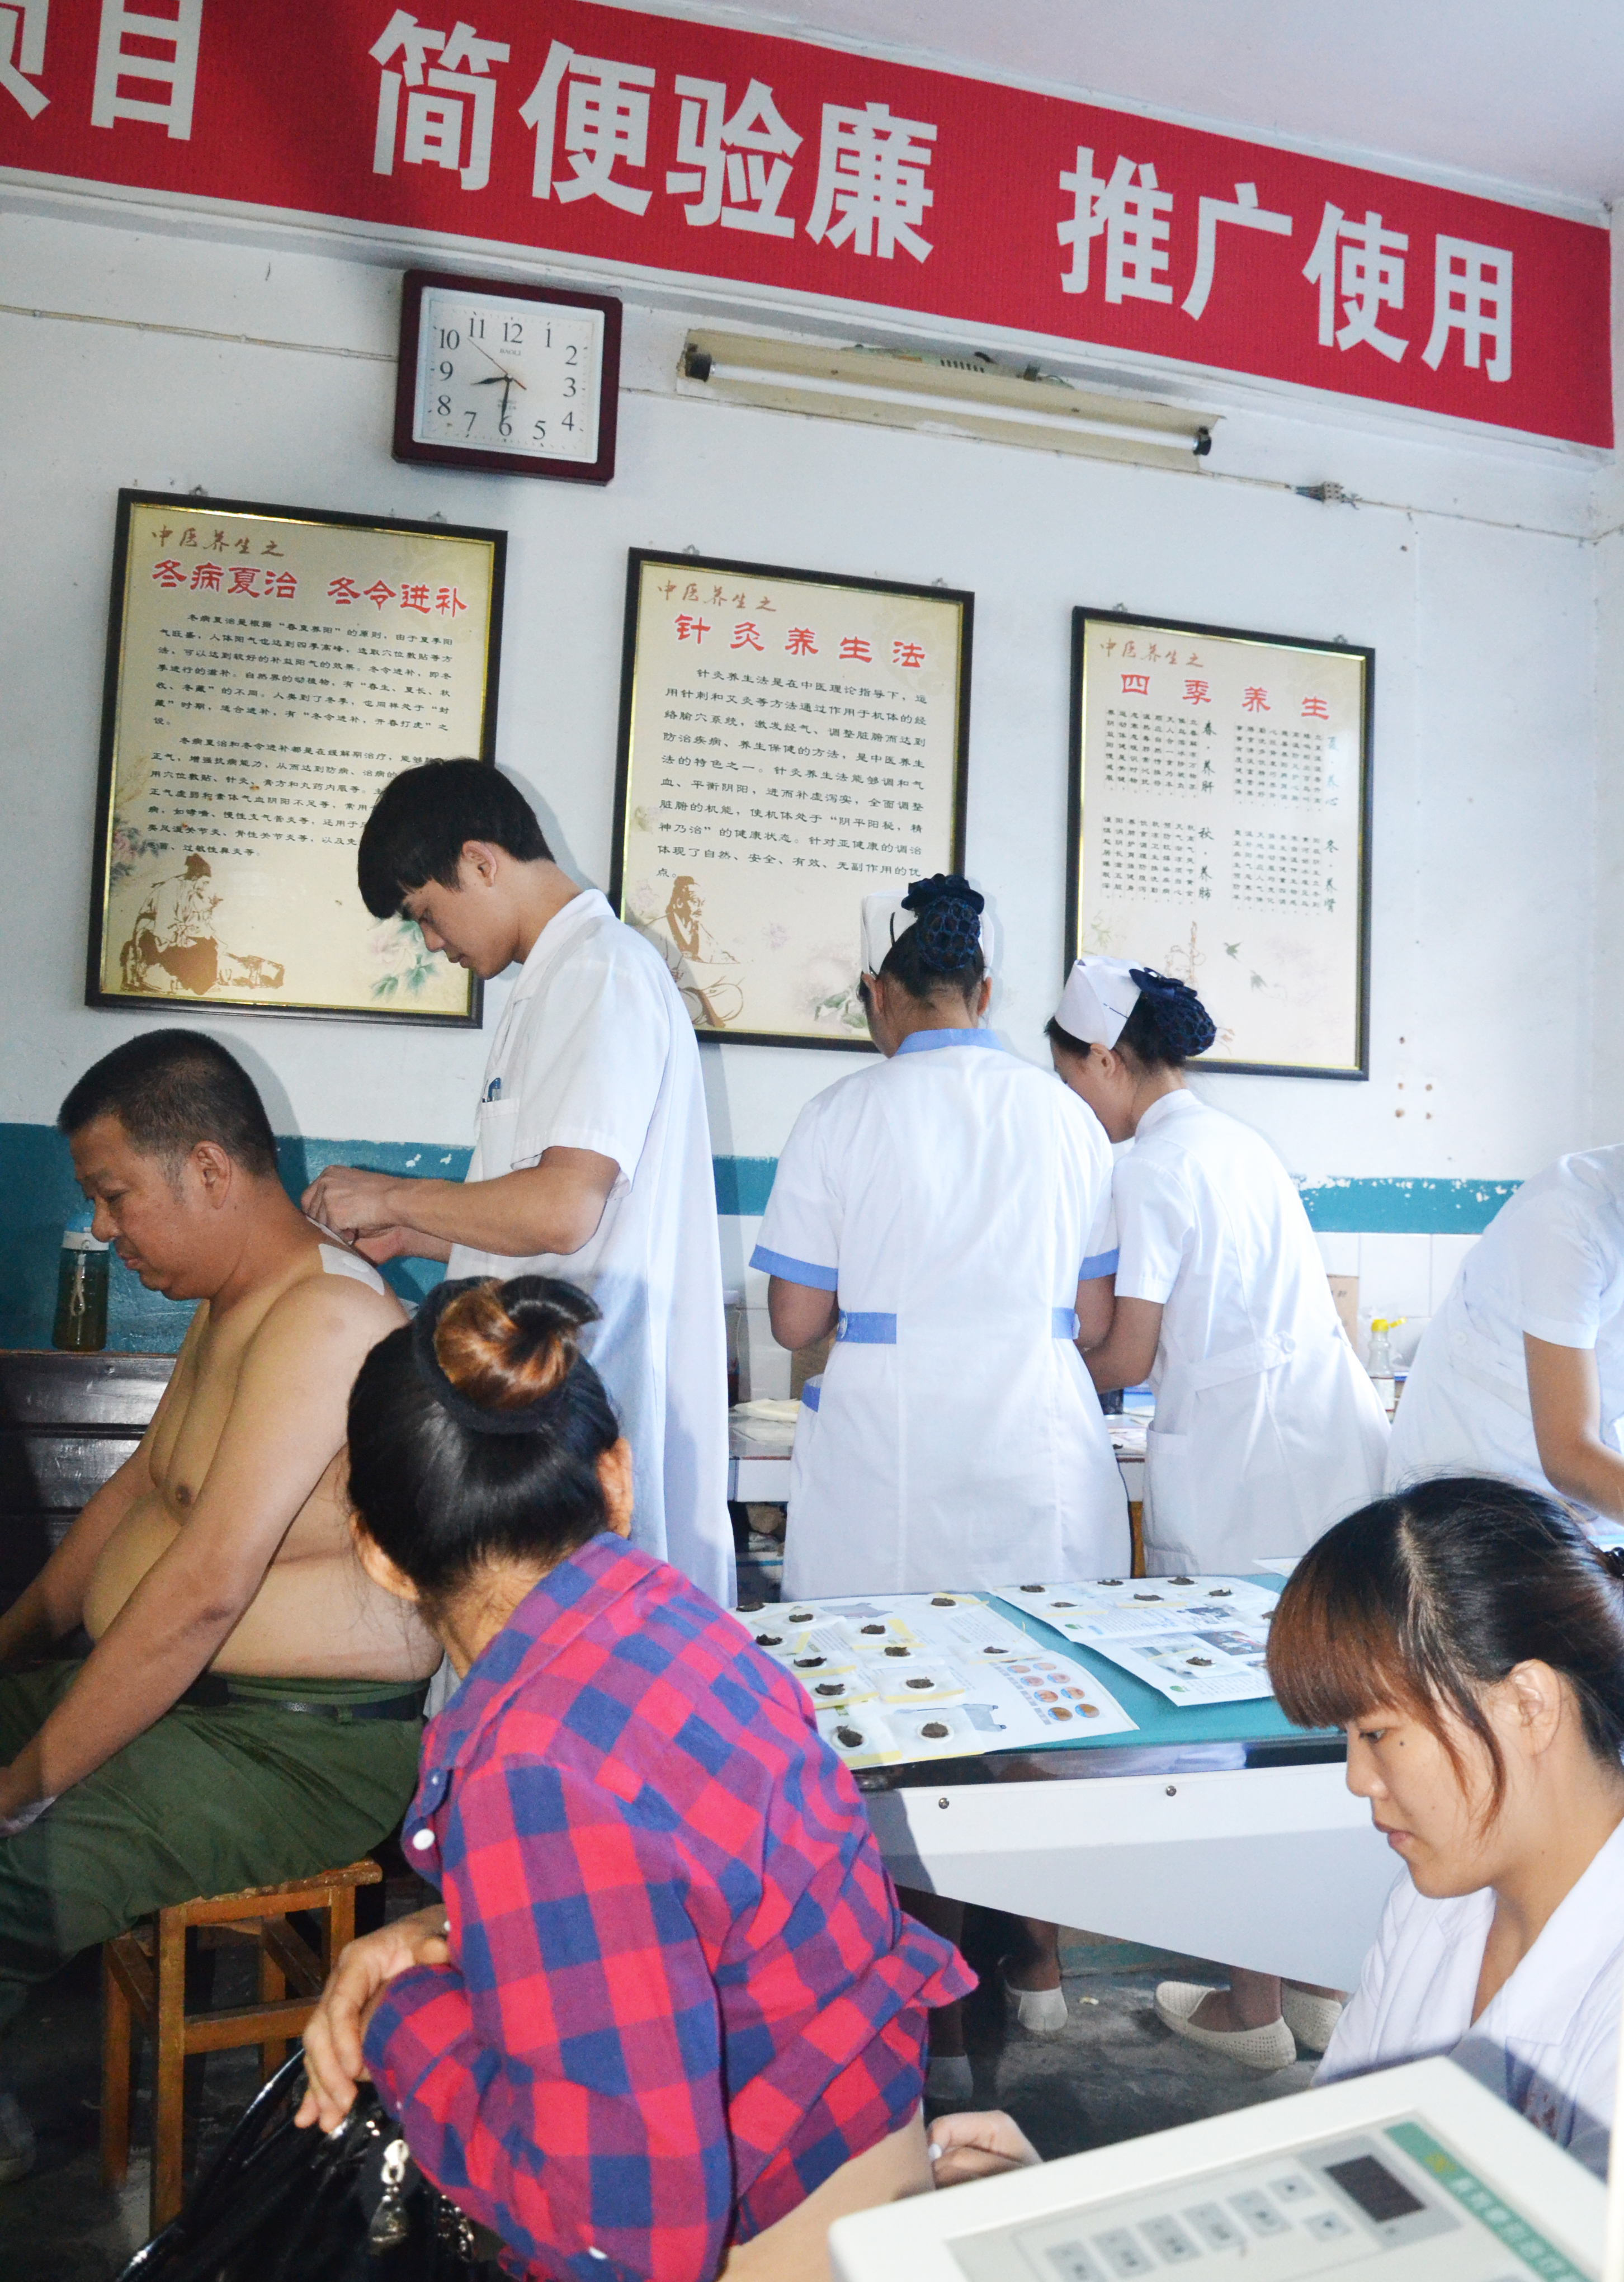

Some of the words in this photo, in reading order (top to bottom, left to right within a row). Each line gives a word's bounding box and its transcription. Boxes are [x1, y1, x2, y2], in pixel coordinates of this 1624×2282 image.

[0, 0, 203, 140] 目
[369, 8, 938, 265] 简便验廉
[1056, 145, 1514, 383] 推广使用
[469, 318, 485, 339] 11
[503, 322, 523, 345] 12
[545, 328, 551, 348] 1
[439, 329, 460, 350] 10
[565, 346, 578, 366] 2
[440, 361, 454, 381] 9
[563, 377, 577, 398] 3
[437, 395, 451, 416] 8
[464, 411, 477, 432] 7
[498, 416, 512, 436] 6
[532, 420, 546, 440] 5
[561, 411, 575, 432] 4
[152, 524, 285, 558] 中医养生之
[152, 559, 298, 600] 冬病夏治
[327, 577, 468, 618] 冬令进补
[657, 579, 777, 612] 中医养生之
[674, 614, 926, 668] 针灸养生法
[1099, 638, 1205, 668] 中医养生之
[1121, 673, 1329, 720] 四季养生
[153, 716, 171, 725] 说。
[148, 804, 366, 829] 病，如哮喘、慢性支气管炎等，还用于
